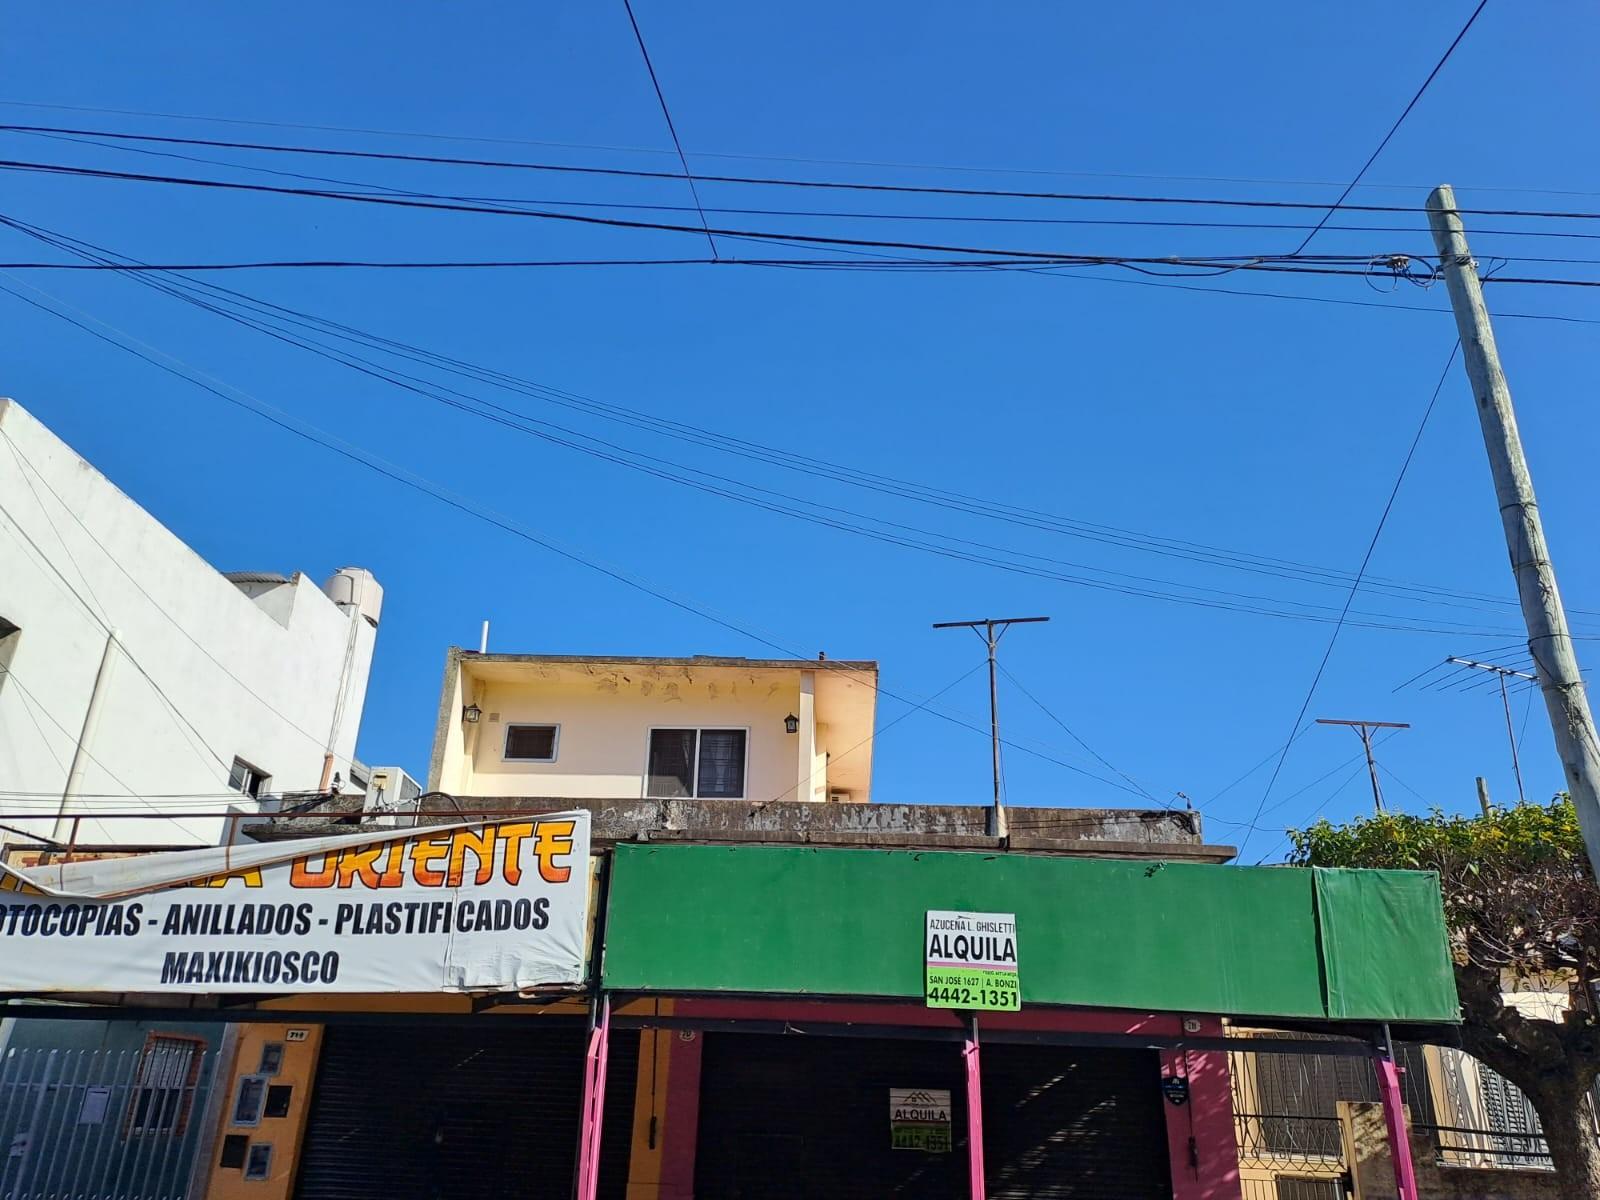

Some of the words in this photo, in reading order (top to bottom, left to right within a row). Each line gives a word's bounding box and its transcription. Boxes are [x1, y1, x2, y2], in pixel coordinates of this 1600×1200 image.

[162, 903, 313, 936] ANILLADOS
[334, 897, 550, 936] PLASTIFICADOS
[930, 919, 966, 931] AZUCENA
[976, 921, 1015, 934] GHISLETTI
[929, 933, 1016, 962] ALQUILA
[161, 950, 340, 984] MAXIKIOSCO
[929, 975, 943, 985] SAN
[963, 977, 979, 986] 1627
[986, 978, 993, 987] A.
[995, 979, 1017, 989] BONZI
[929, 987, 1017, 1007] 4442-1351
[895, 1109, 947, 1121] ALQUILA
